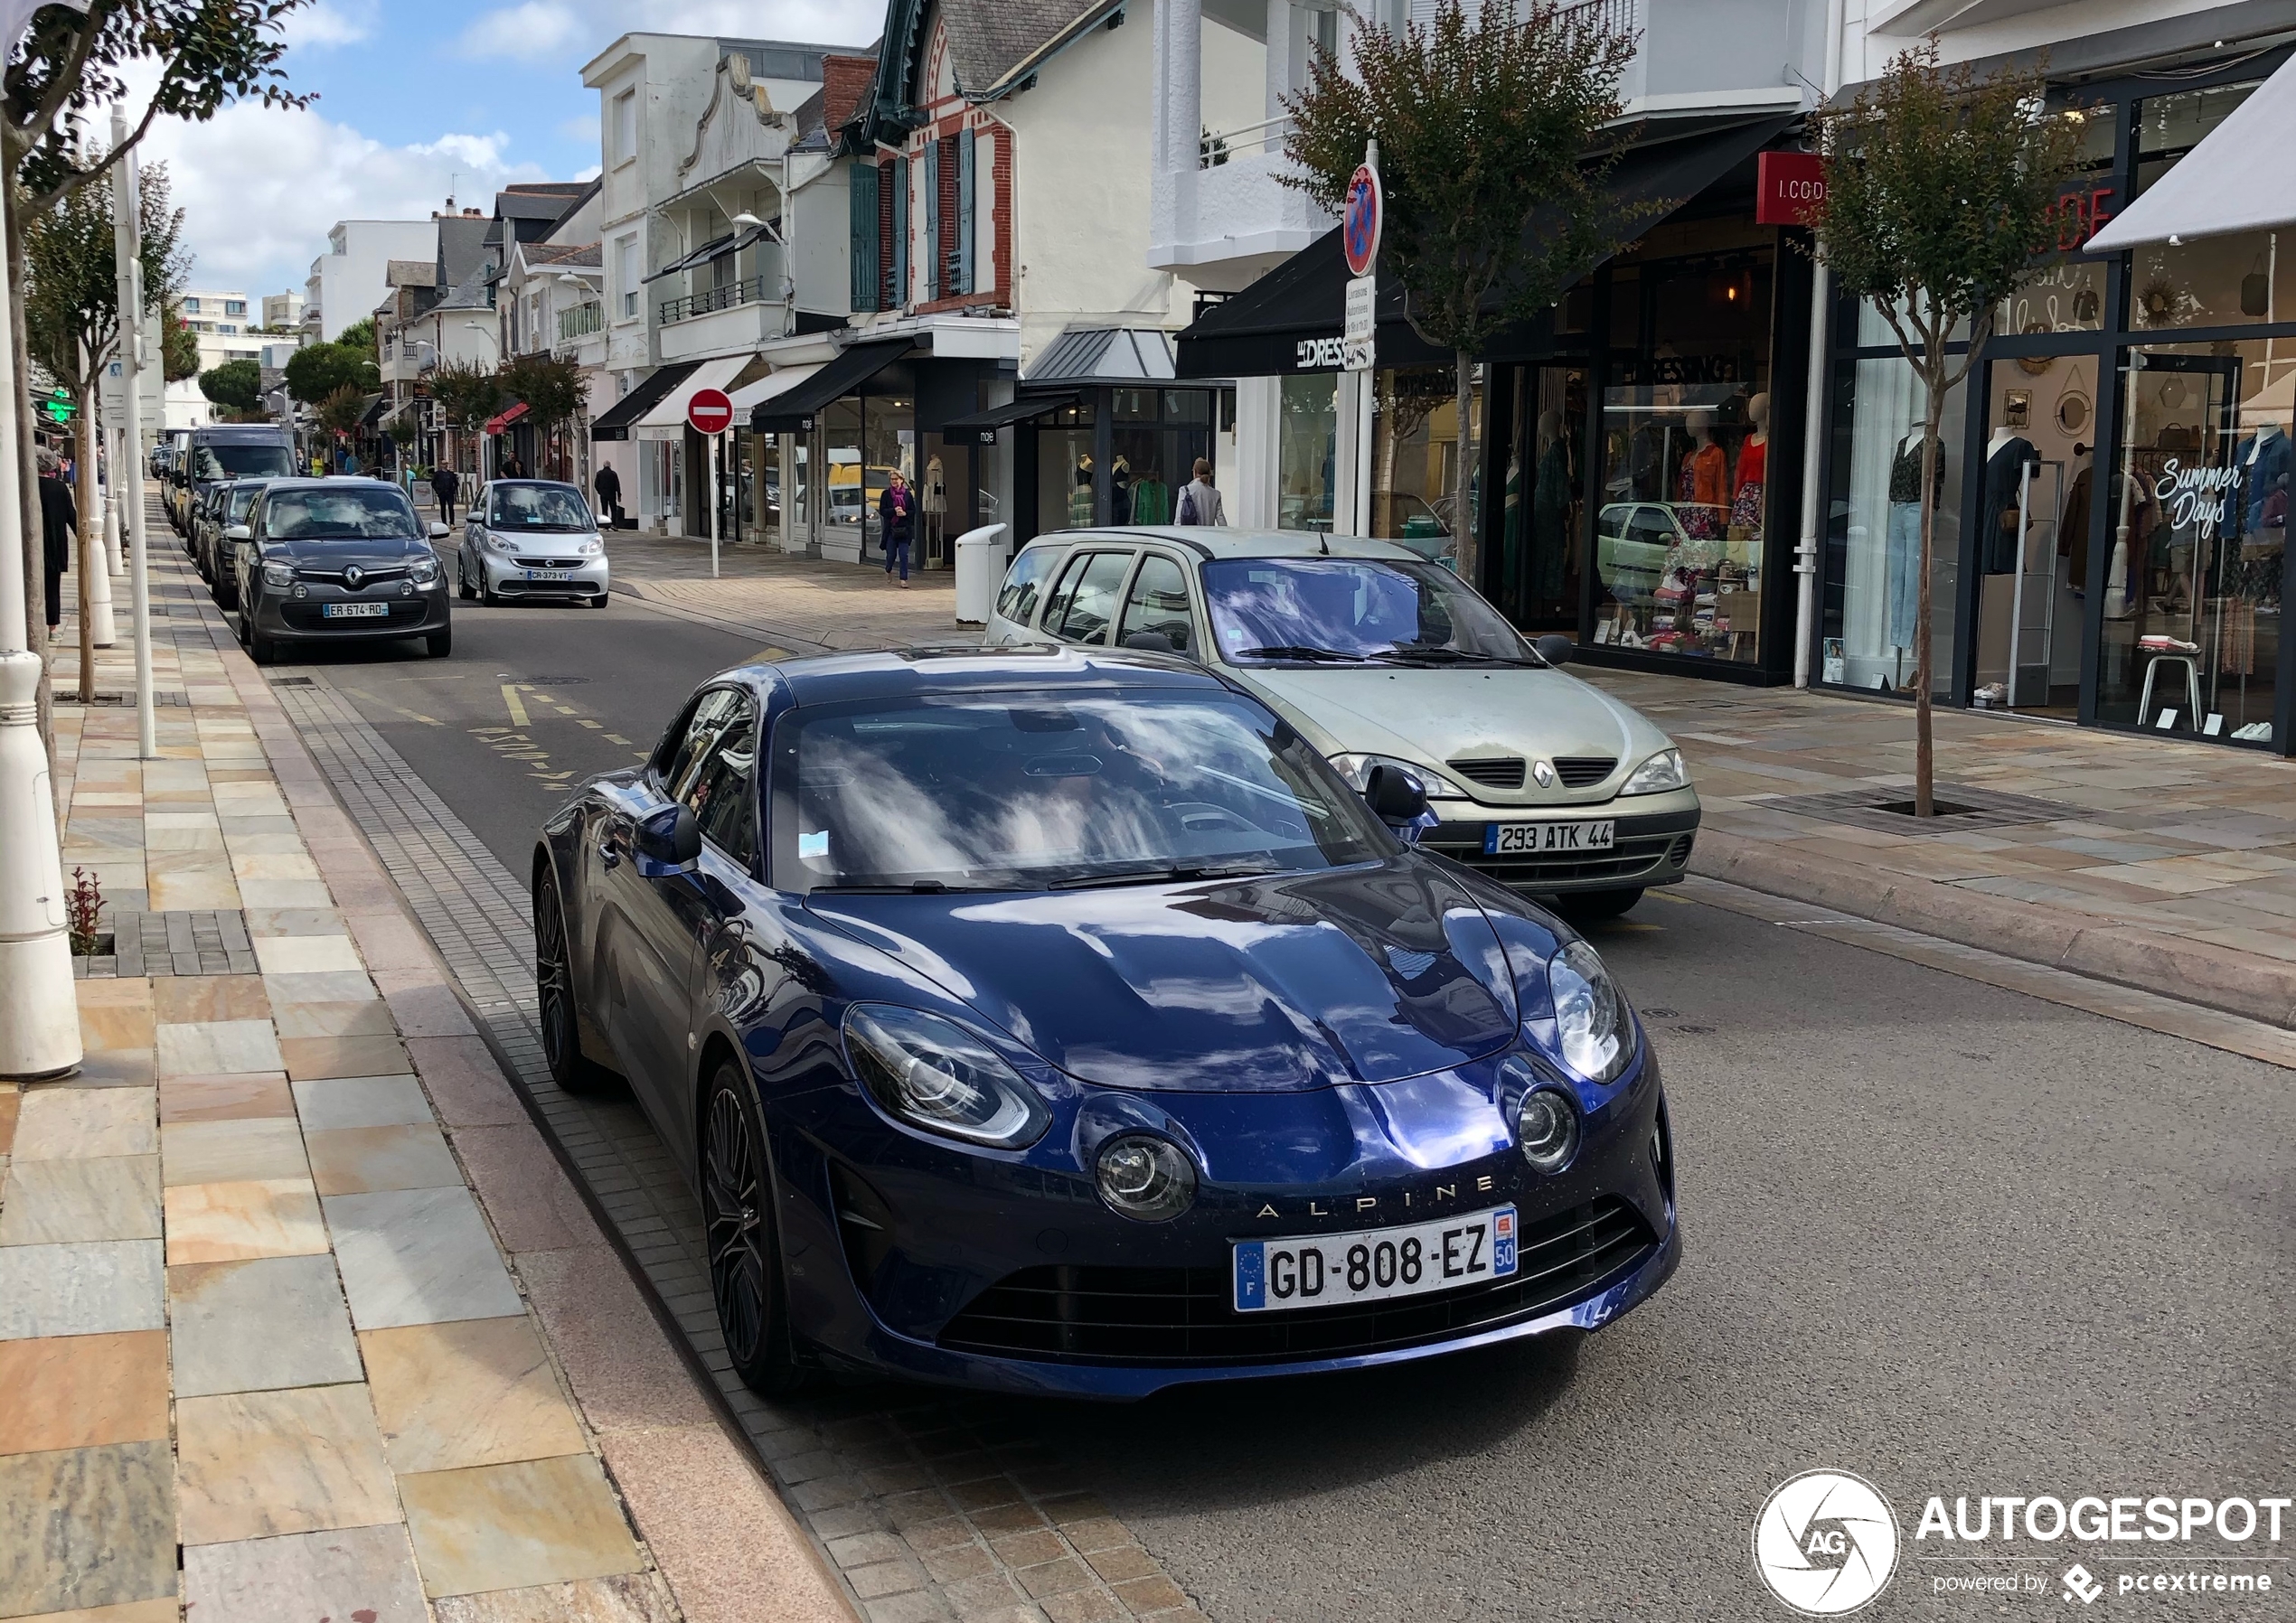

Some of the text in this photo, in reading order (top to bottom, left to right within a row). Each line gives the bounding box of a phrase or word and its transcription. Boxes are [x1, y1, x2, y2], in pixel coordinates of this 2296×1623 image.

[2154, 457, 2243, 500] Summer
[2170, 491, 2225, 539] Days
[1501, 823, 1611, 851] 293 ATK 44
[1256, 1175, 1493, 1218] ALPINE
[1270, 1224, 1487, 1299] GD-808-EZ
[1495, 1243, 1514, 1267] 50
[1246, 1281, 1255, 1296] F
